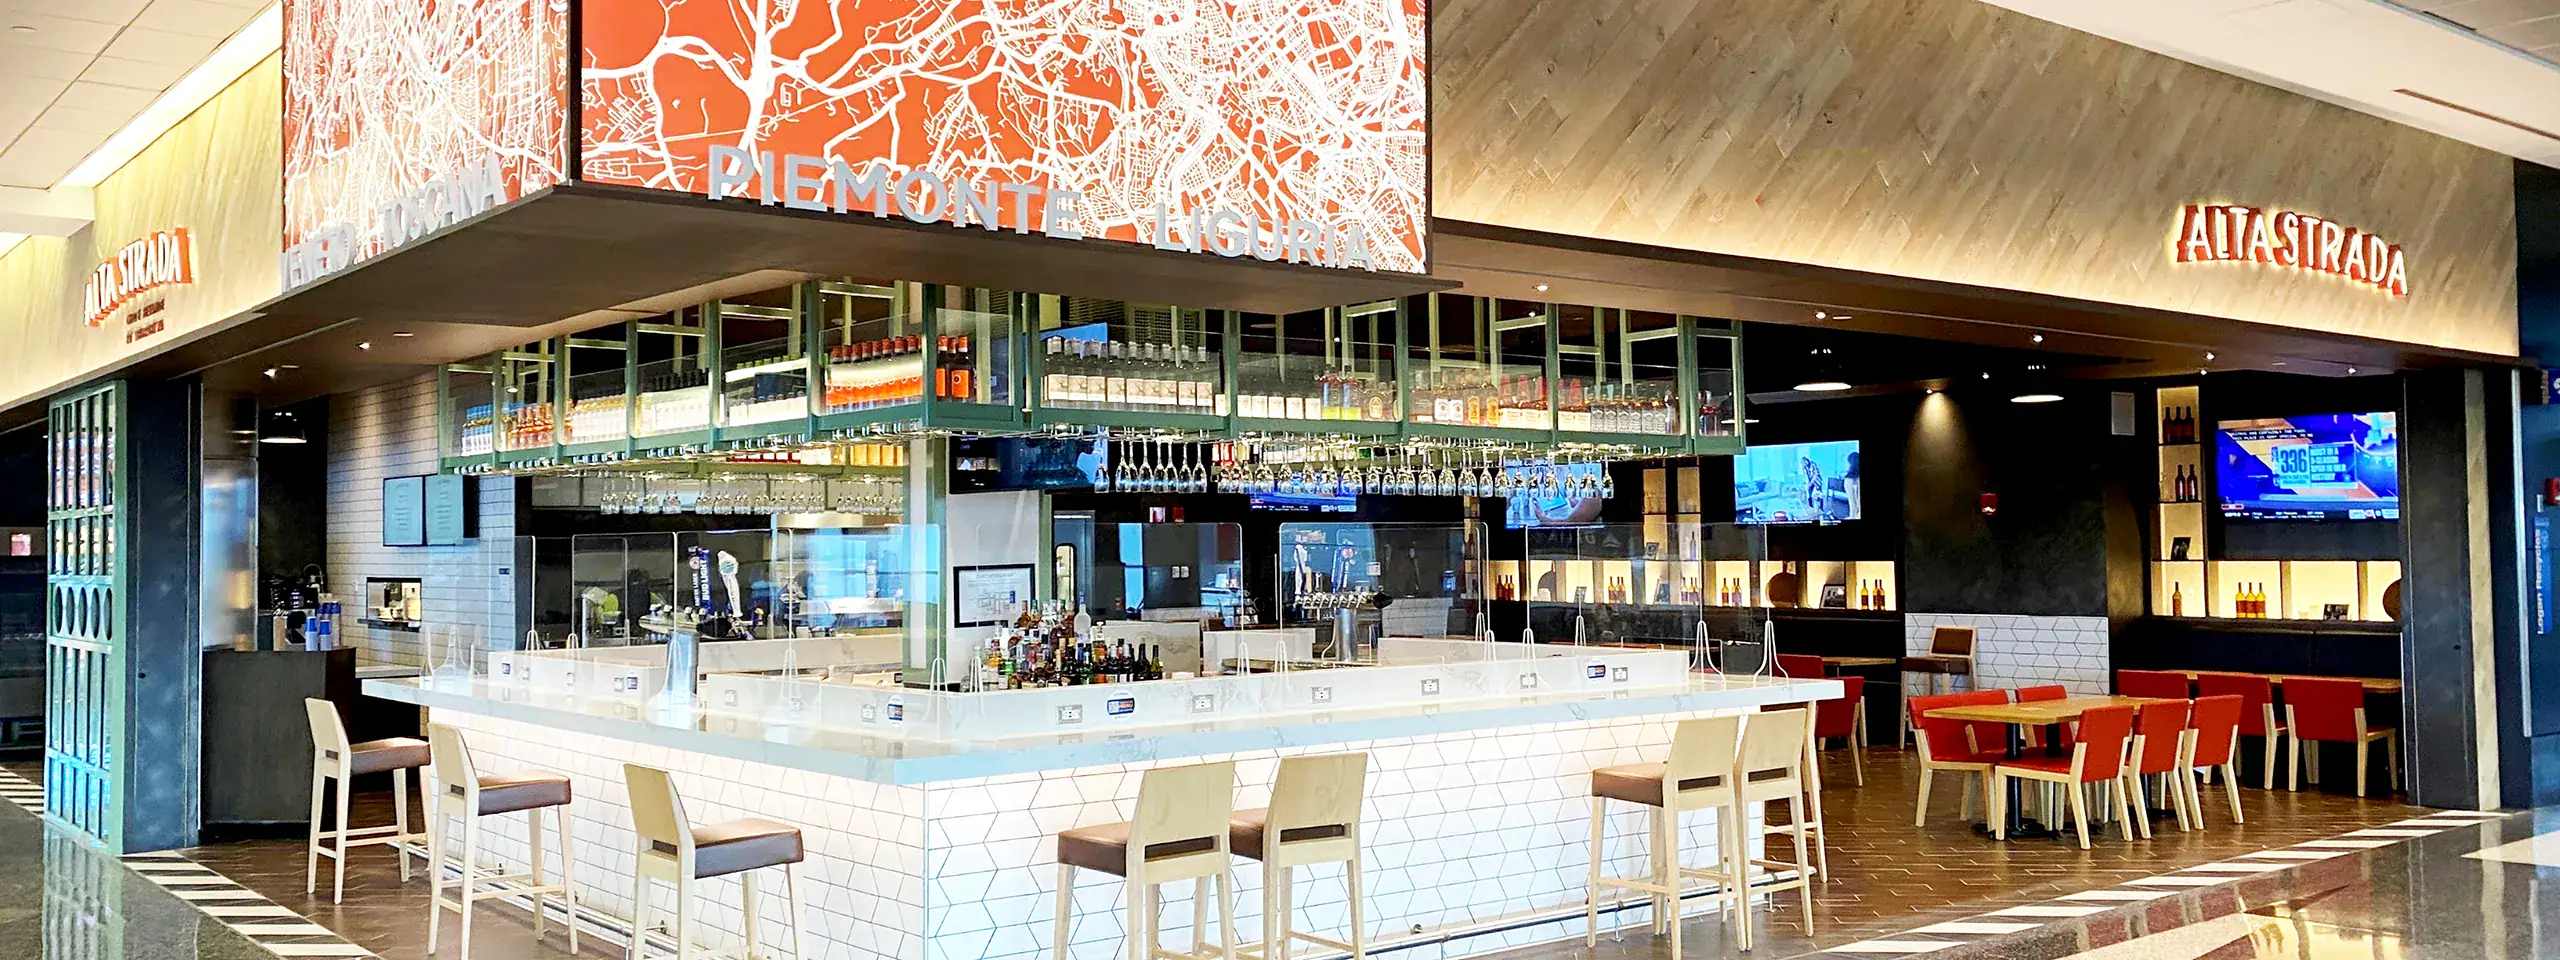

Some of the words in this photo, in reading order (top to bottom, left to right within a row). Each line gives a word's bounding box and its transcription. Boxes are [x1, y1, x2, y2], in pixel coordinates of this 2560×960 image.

[377, 155, 508, 251] TOSCANA
[707, 144, 1083, 241] PIEMONTE
[1154, 200, 1377, 272] LIGURIA
[84, 261, 118, 326] ALTA
[118, 230, 188, 297] STRADA
[2178, 205, 2272, 263] ALTA
[2273, 211, 2408, 296] STRADA
[2280, 448, 2307, 473] 336
[700, 559, 708, 583] LIGHT
[701, 584, 710, 601] BUD
[2537, 593, 2545, 634] Logan
